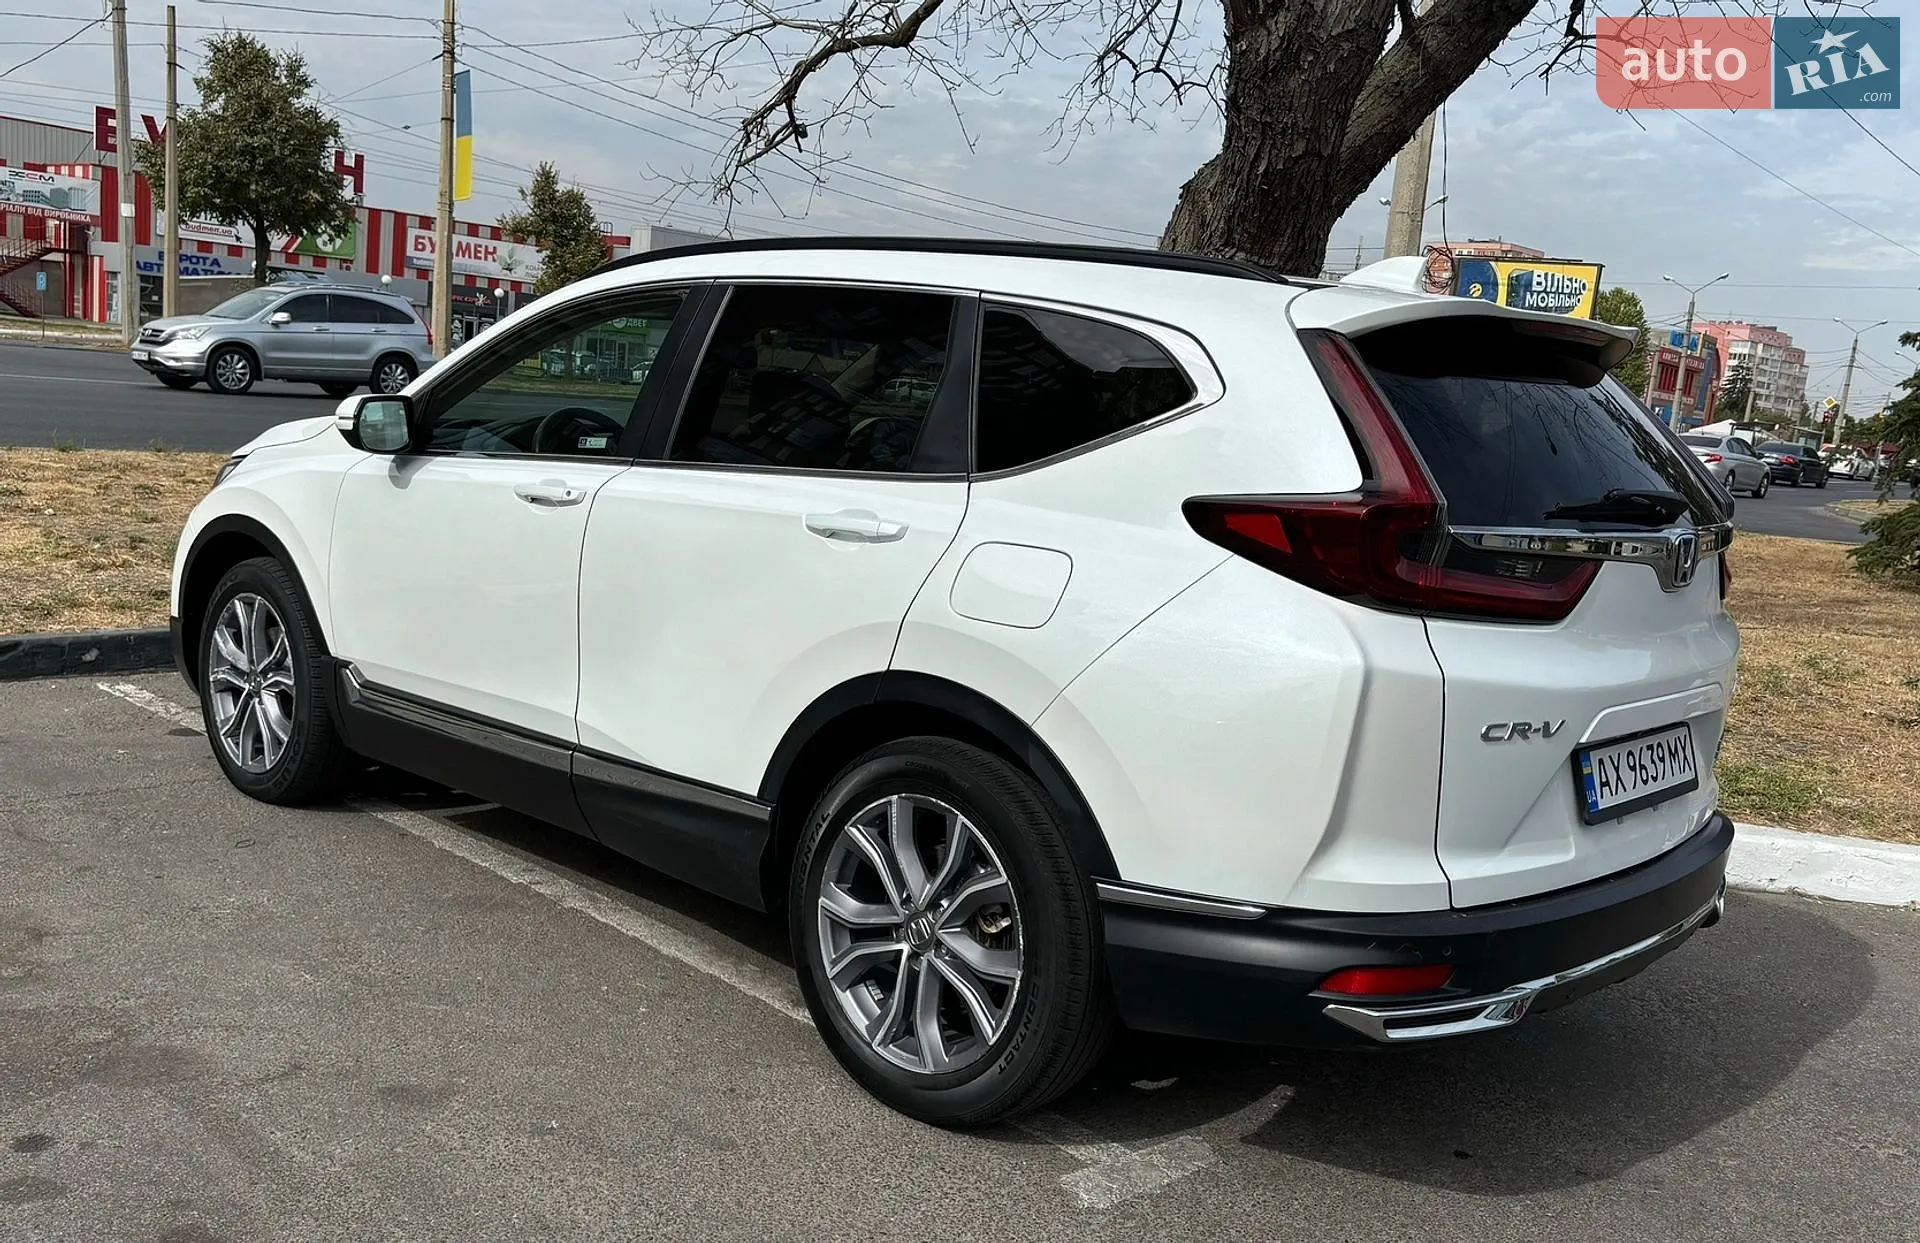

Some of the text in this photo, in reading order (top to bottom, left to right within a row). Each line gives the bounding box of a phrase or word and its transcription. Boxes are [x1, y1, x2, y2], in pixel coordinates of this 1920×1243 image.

[28, 207, 43, 217] ВІД
[44, 209, 91, 222] ВИРОБНИКА
[414, 234, 498, 262] БУМЕН
[1532, 269, 1588, 295] ВІЛЬНО
[1525, 291, 1582, 308] МОБІЛЬНО
[1480, 719, 1567, 742] CR-V
[1598, 734, 1692, 799] AX 9639 MX
